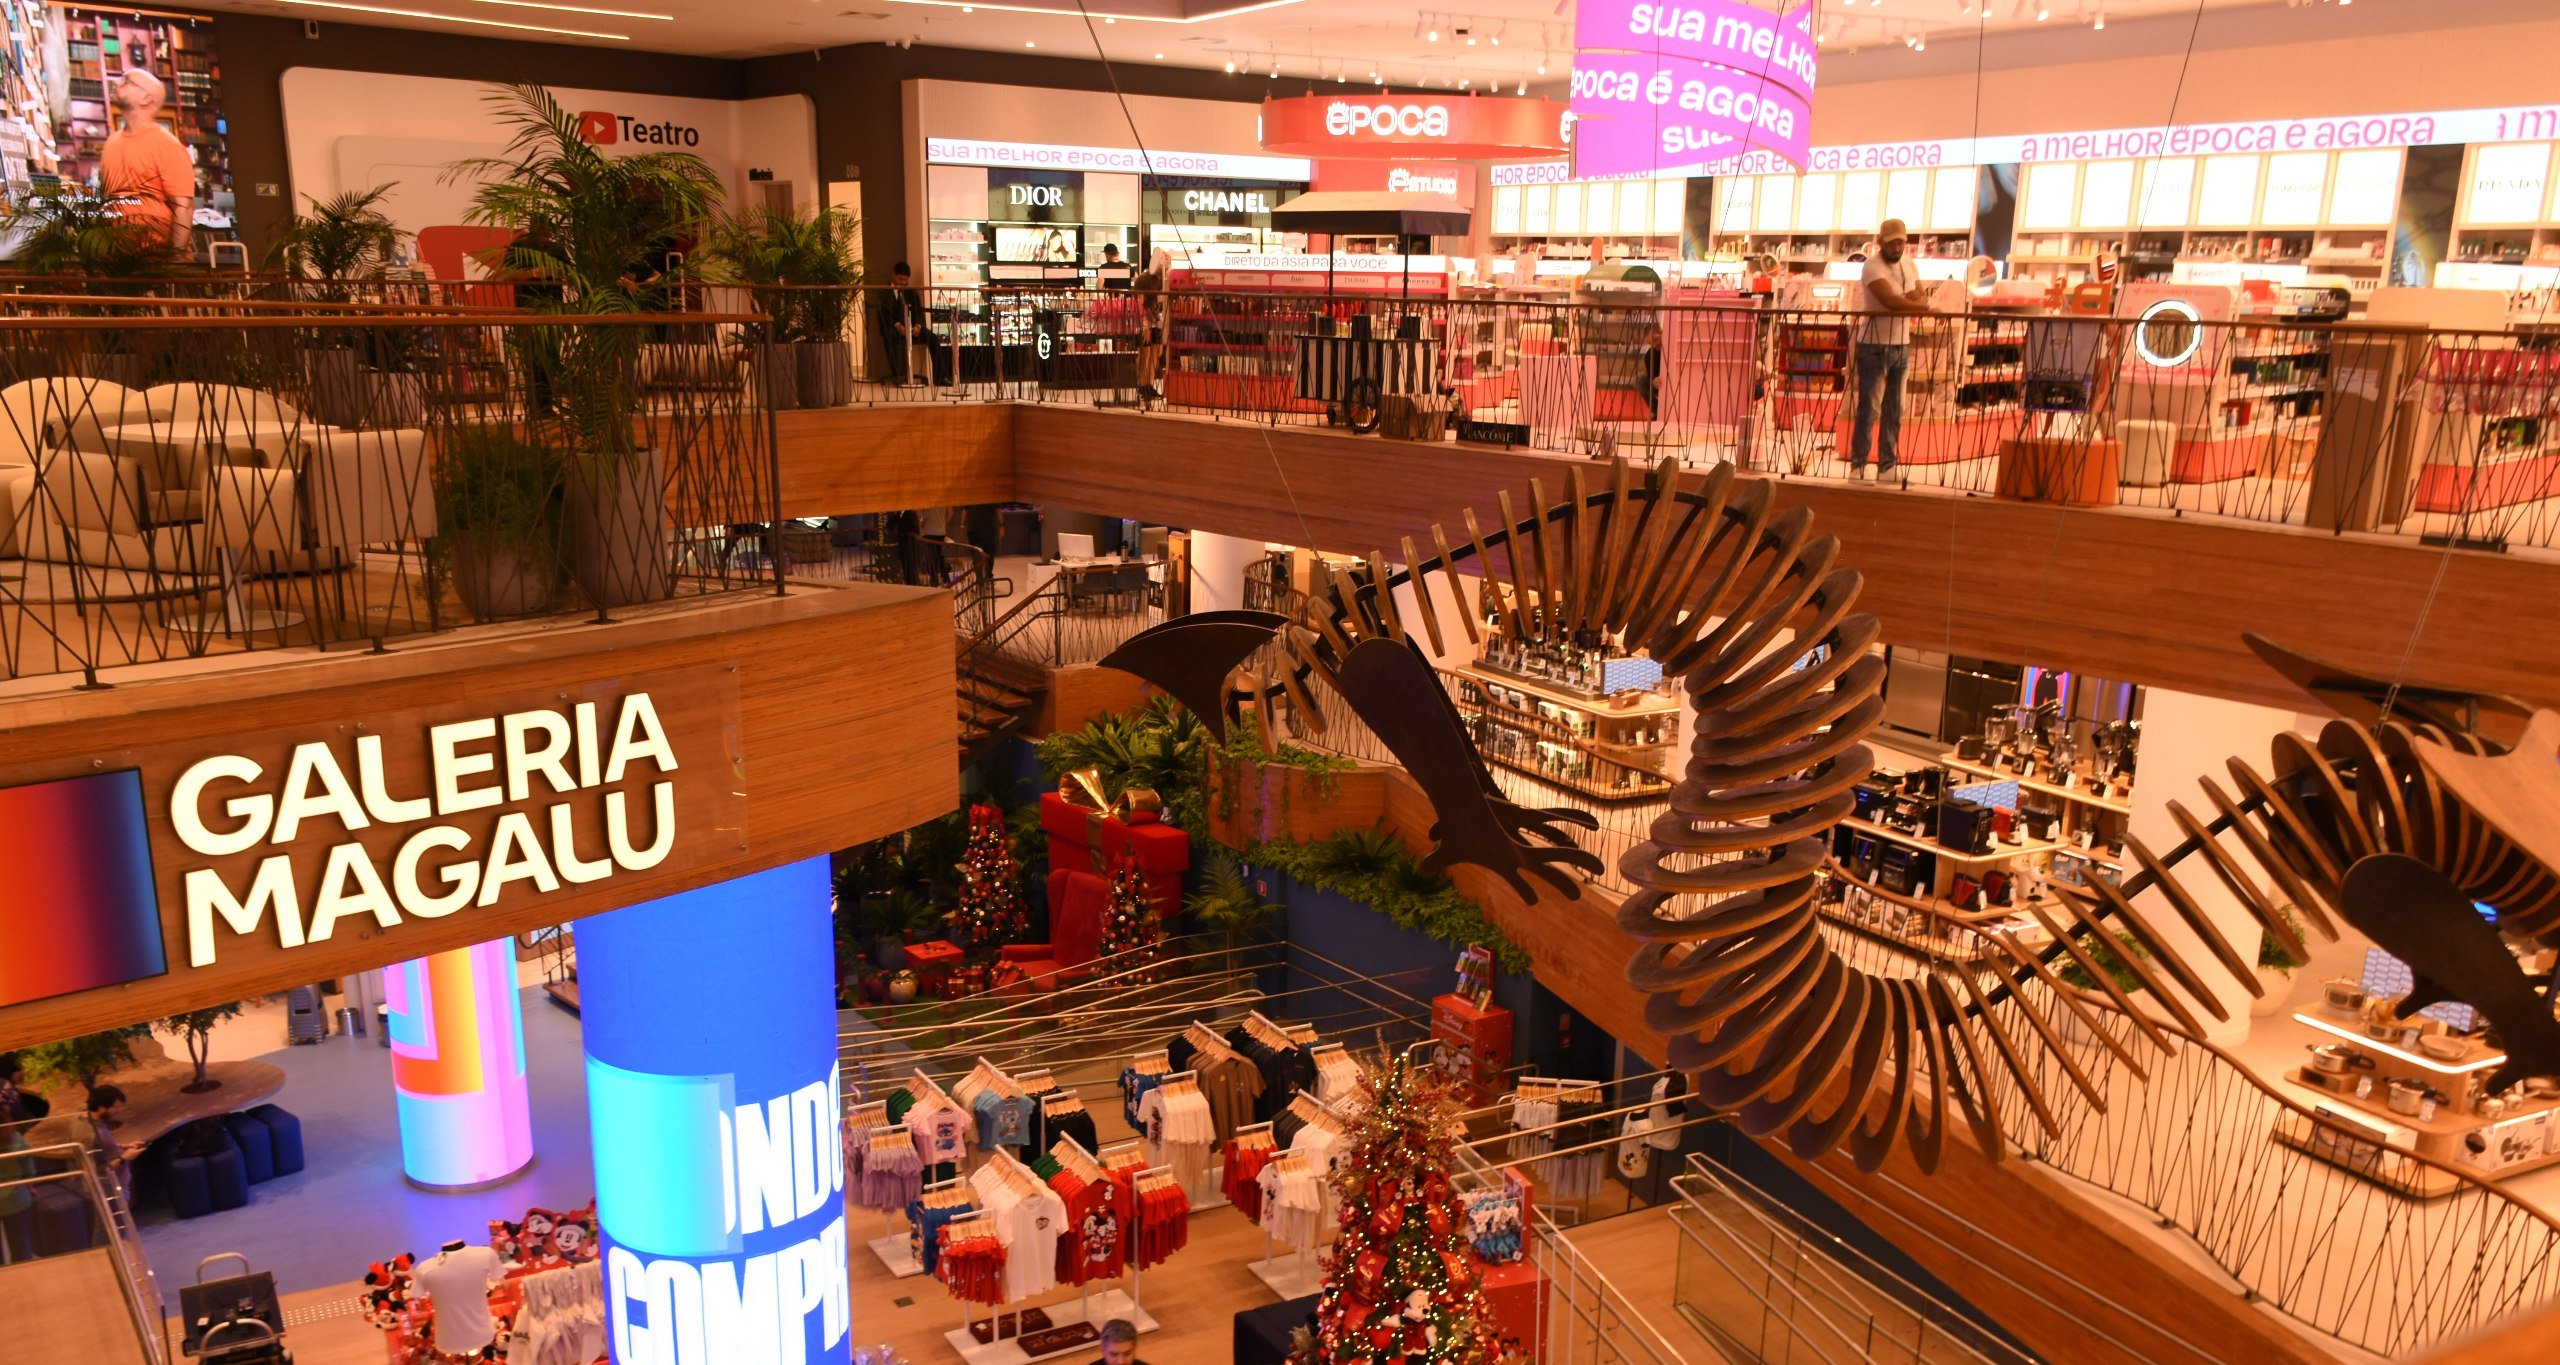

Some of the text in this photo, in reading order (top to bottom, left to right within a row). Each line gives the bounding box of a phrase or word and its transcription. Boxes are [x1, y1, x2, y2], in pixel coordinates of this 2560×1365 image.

[617, 116, 699, 147] Teatro
[1010, 185, 1063, 207] DIOR
[1184, 190, 1270, 213] CHANEL
[170, 691, 679, 857] GALERIA
[183, 780, 677, 969] MAGALU
